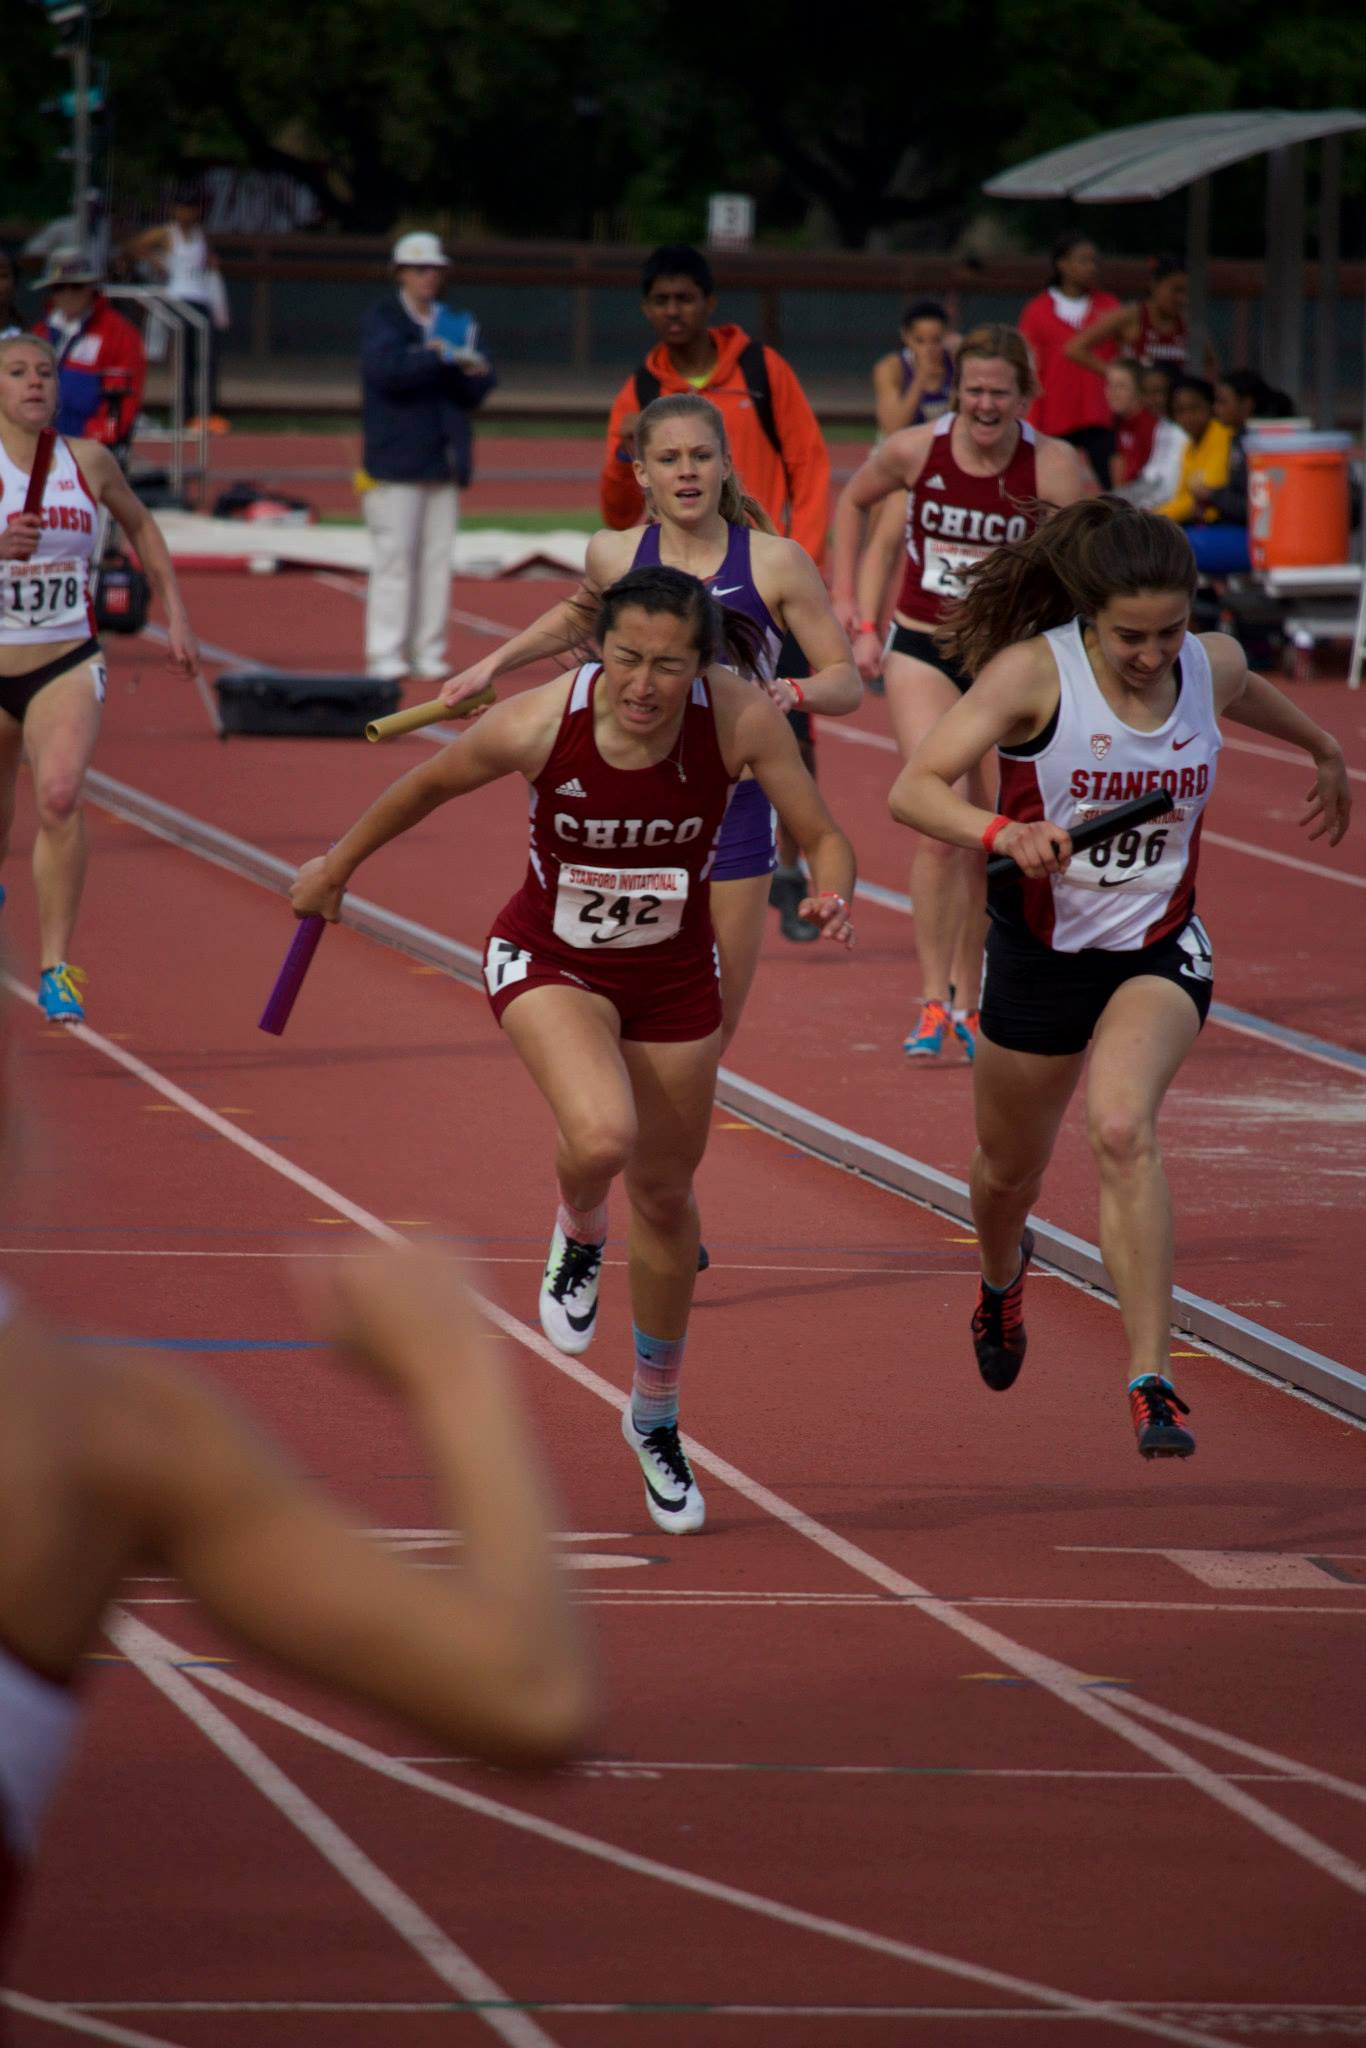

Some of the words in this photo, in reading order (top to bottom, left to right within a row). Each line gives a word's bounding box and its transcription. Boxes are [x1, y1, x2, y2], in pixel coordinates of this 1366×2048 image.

[921, 501, 1027, 544] CHICO
[10, 576, 77, 612] 1378
[1070, 763, 1208, 801] STANFORD
[554, 812, 703, 849] CHICO
[568, 867, 616, 890] STANFORD
[618, 873, 678, 892] INVITATIONAL
[579, 889, 662, 926] 242
